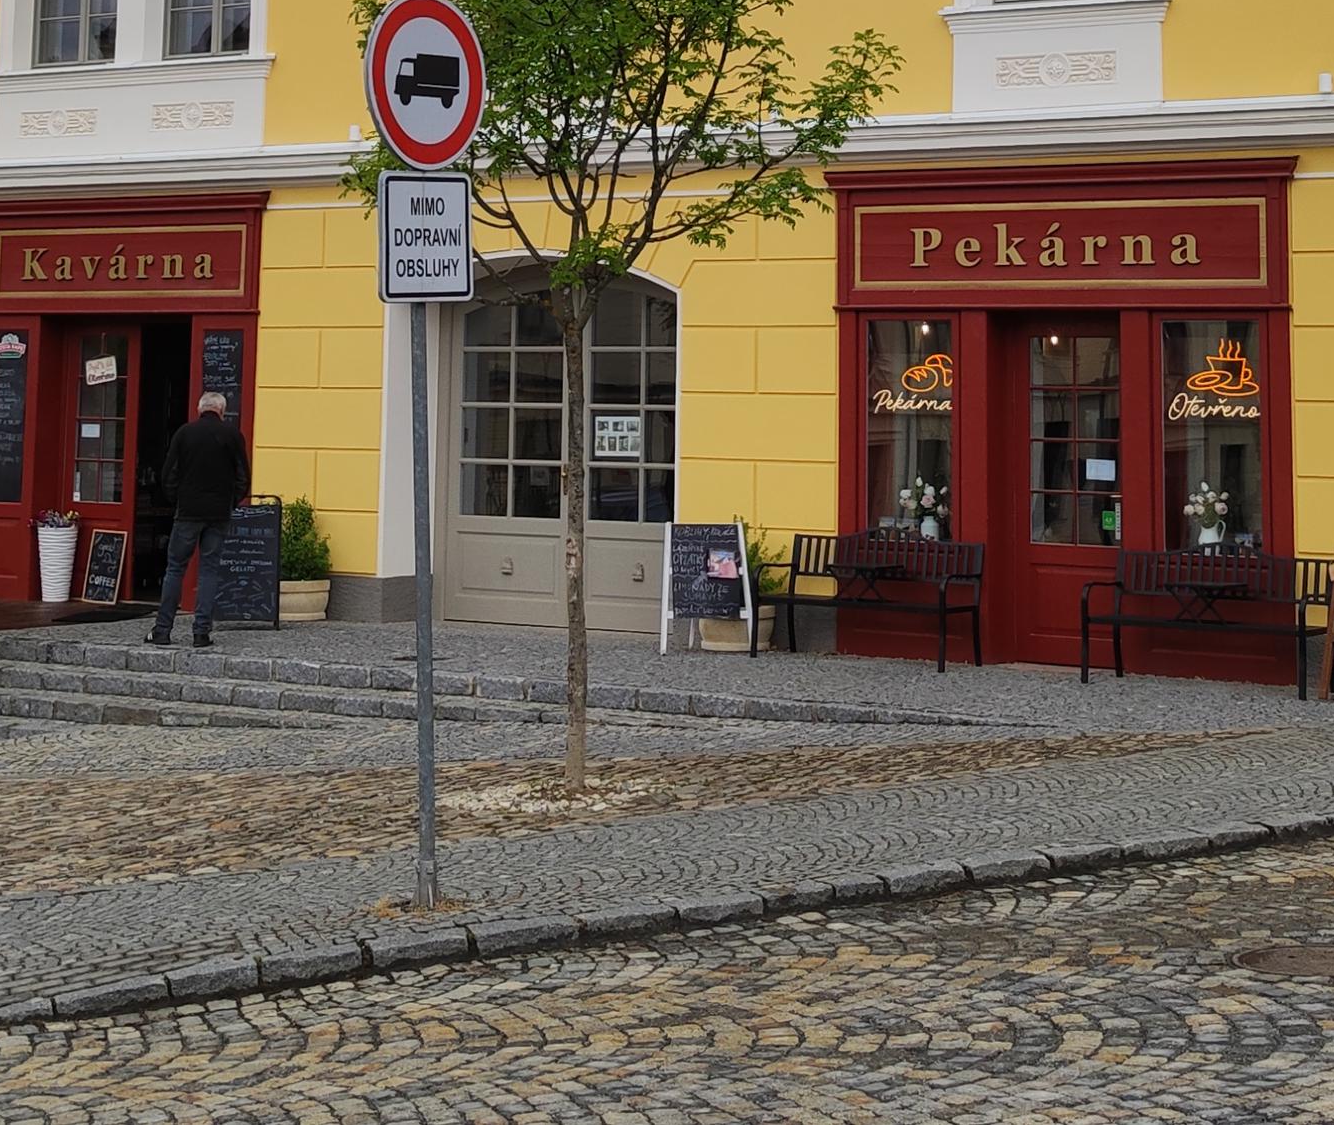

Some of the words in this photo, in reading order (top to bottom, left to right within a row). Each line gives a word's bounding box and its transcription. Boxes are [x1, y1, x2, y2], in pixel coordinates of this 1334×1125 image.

[410, 197, 445, 217] MIMO
[394, 223, 462, 247] DOPRAVNÍ
[909, 222, 1201, 268] Pekárna
[20, 244, 214, 281] Kavárna
[396, 258, 460, 278] OBSLUHY
[872, 389, 953, 414] Pekárna
[1168, 392, 1261, 421] Otevřeno
[88, 574, 116, 588] COFFEE
